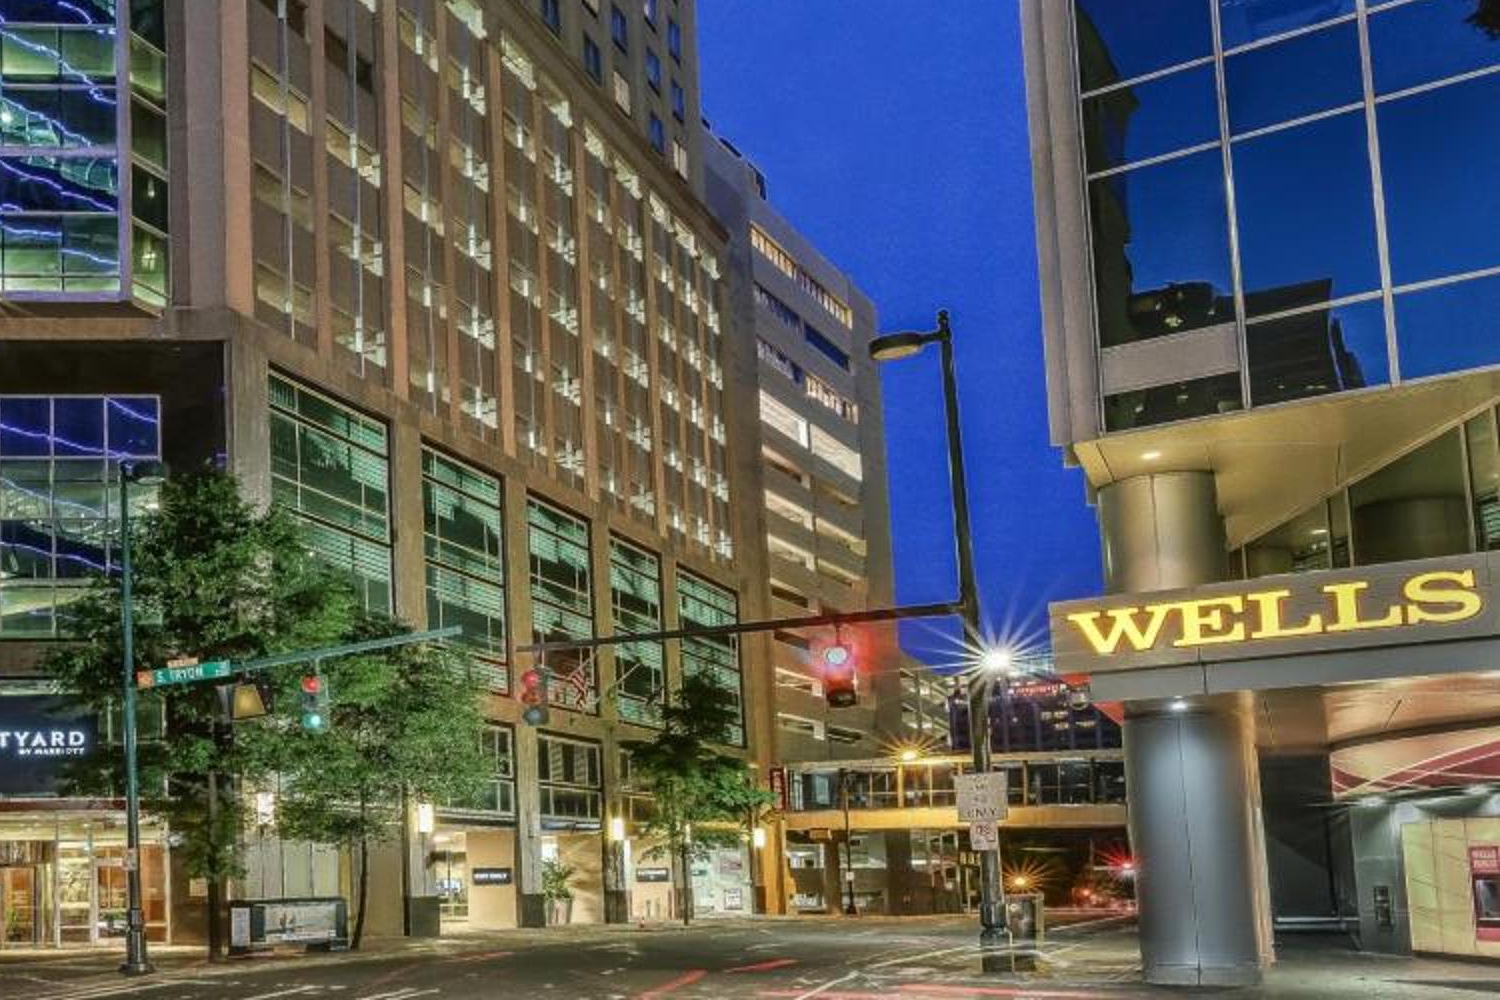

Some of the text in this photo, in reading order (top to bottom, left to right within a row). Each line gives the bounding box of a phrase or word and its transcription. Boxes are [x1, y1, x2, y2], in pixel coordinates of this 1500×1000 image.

[1068, 568, 1482, 655] WELLS
[169, 665, 204, 683] TRYON
[18, 747, 85, 755] BY MARRIOTT
